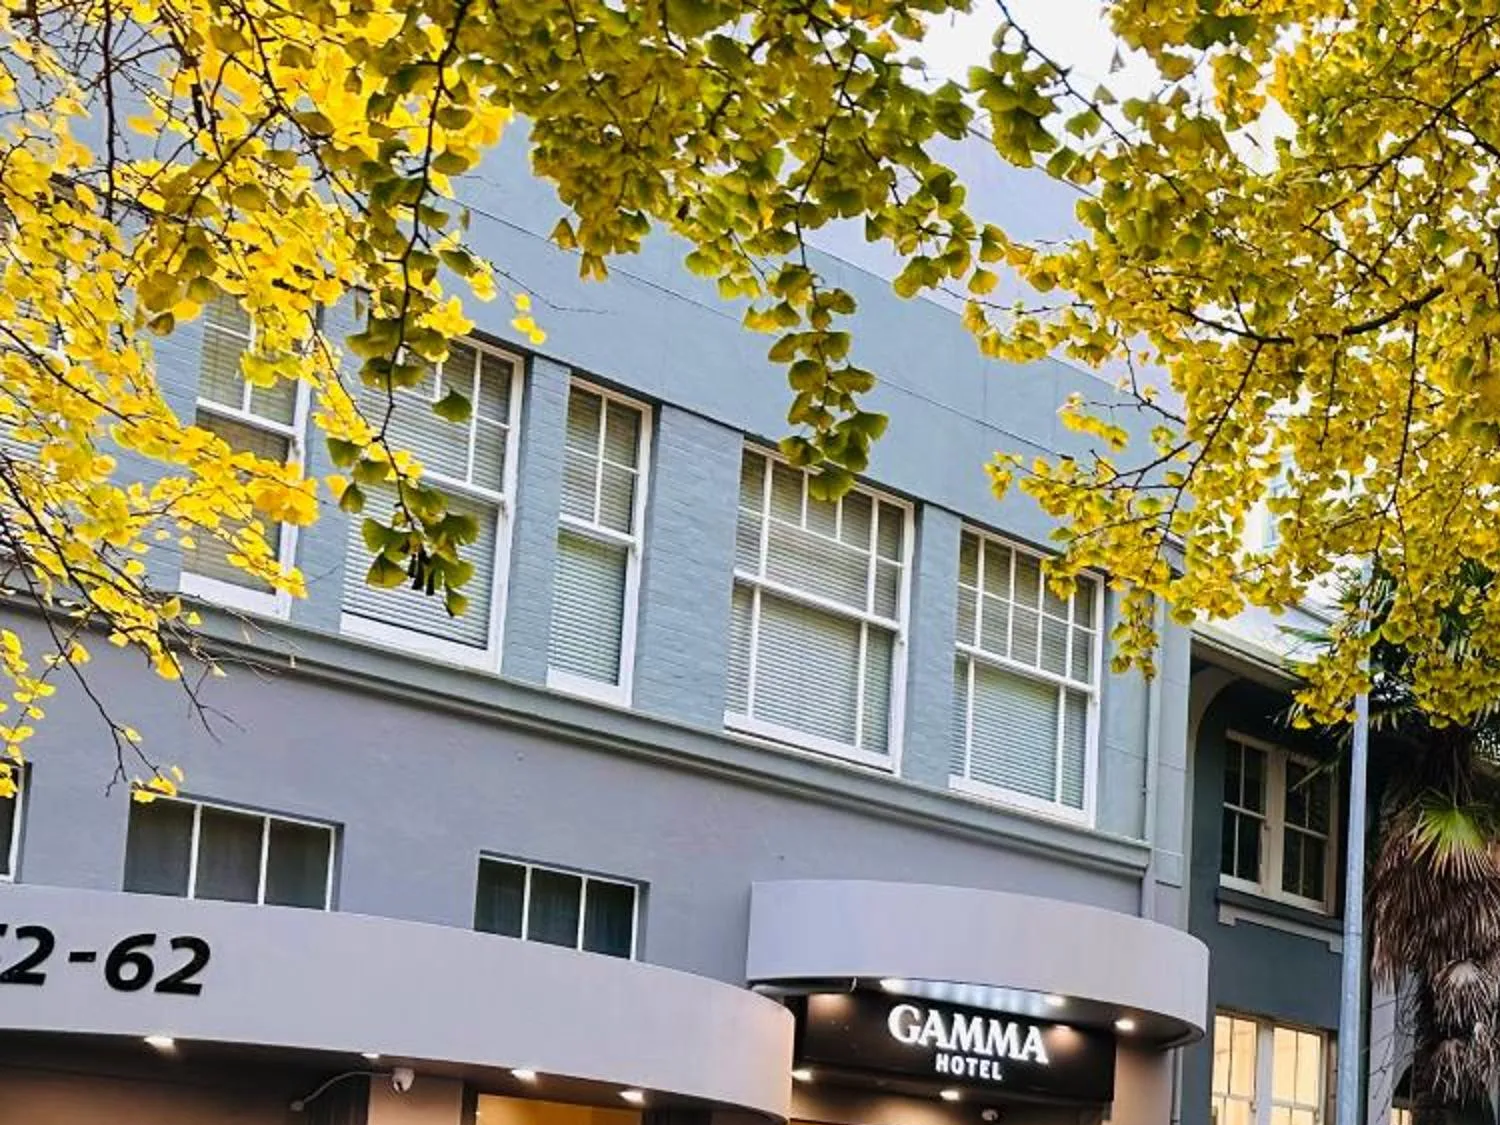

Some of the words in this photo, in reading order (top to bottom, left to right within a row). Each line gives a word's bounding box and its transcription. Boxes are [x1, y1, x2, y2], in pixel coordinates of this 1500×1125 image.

[0, 924, 211, 996] 2-62
[887, 1004, 1049, 1064] GAMMA
[935, 1053, 1003, 1080] HOTEL
